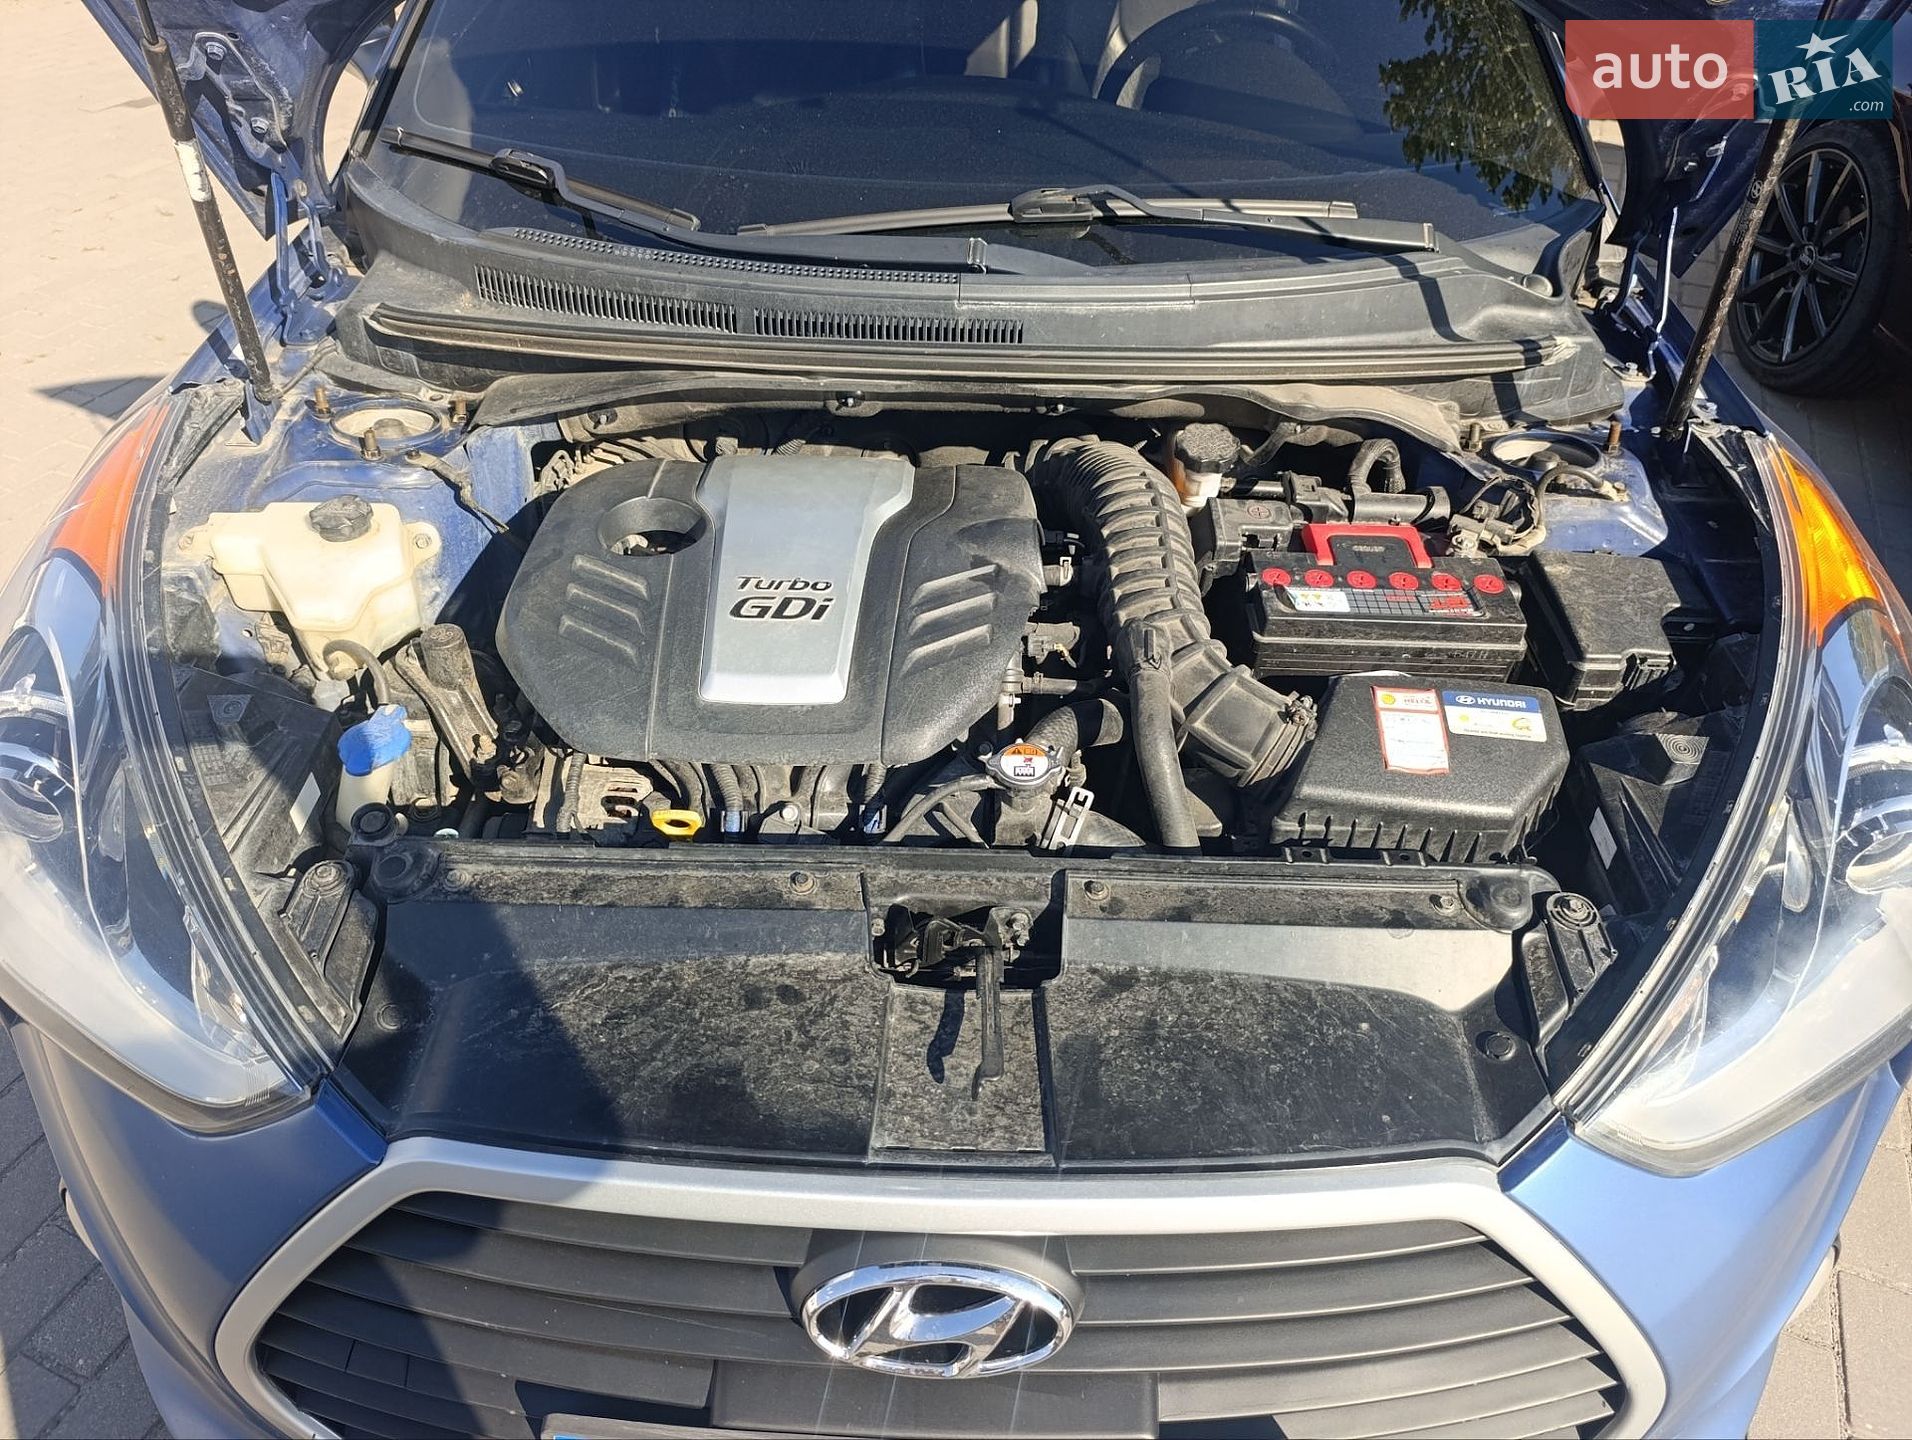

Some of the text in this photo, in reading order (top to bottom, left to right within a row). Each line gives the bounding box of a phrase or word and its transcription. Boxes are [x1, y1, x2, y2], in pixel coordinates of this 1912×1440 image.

[737, 576, 832, 591] Turbo
[729, 596, 834, 620] GDi
[1477, 697, 1527, 709] HYUNDAI
